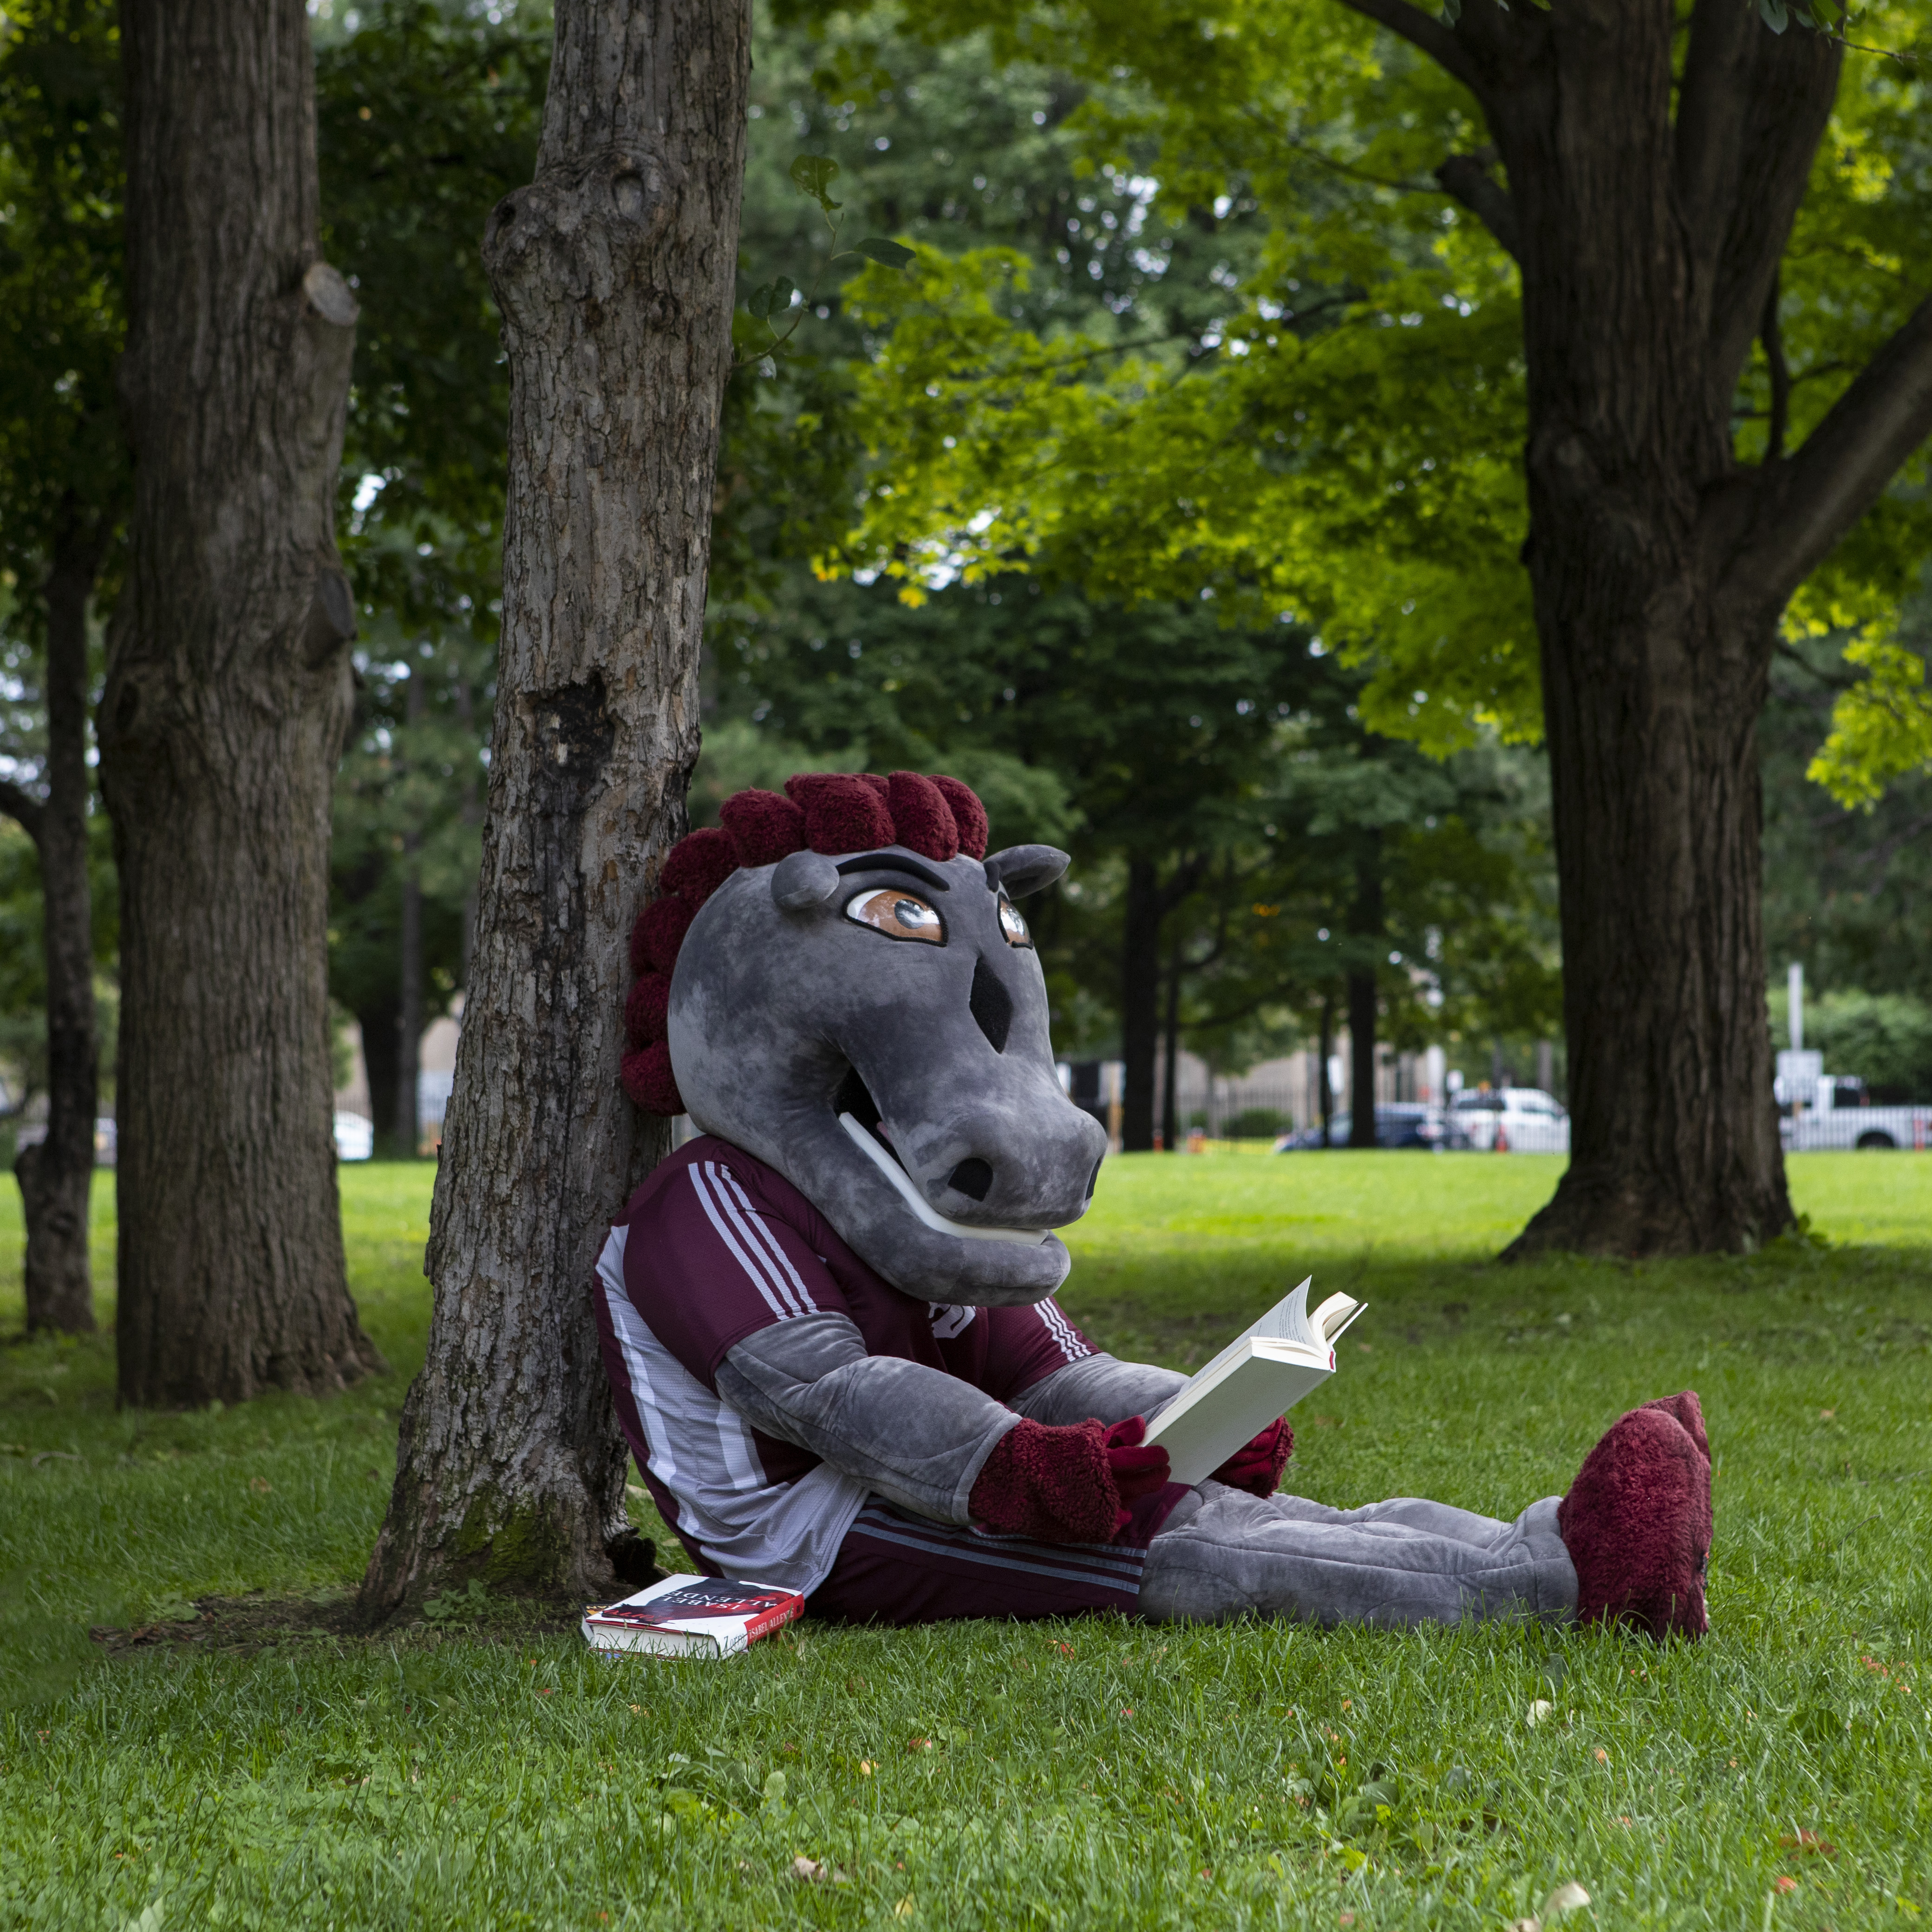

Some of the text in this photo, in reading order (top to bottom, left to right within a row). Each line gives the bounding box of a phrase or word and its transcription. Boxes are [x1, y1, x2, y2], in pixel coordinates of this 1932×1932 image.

[661, 1595, 741, 1610] ISABEL
[667, 1591, 778, 1607] ALLENDE
[749, 1622, 769, 1639] ISABEL
